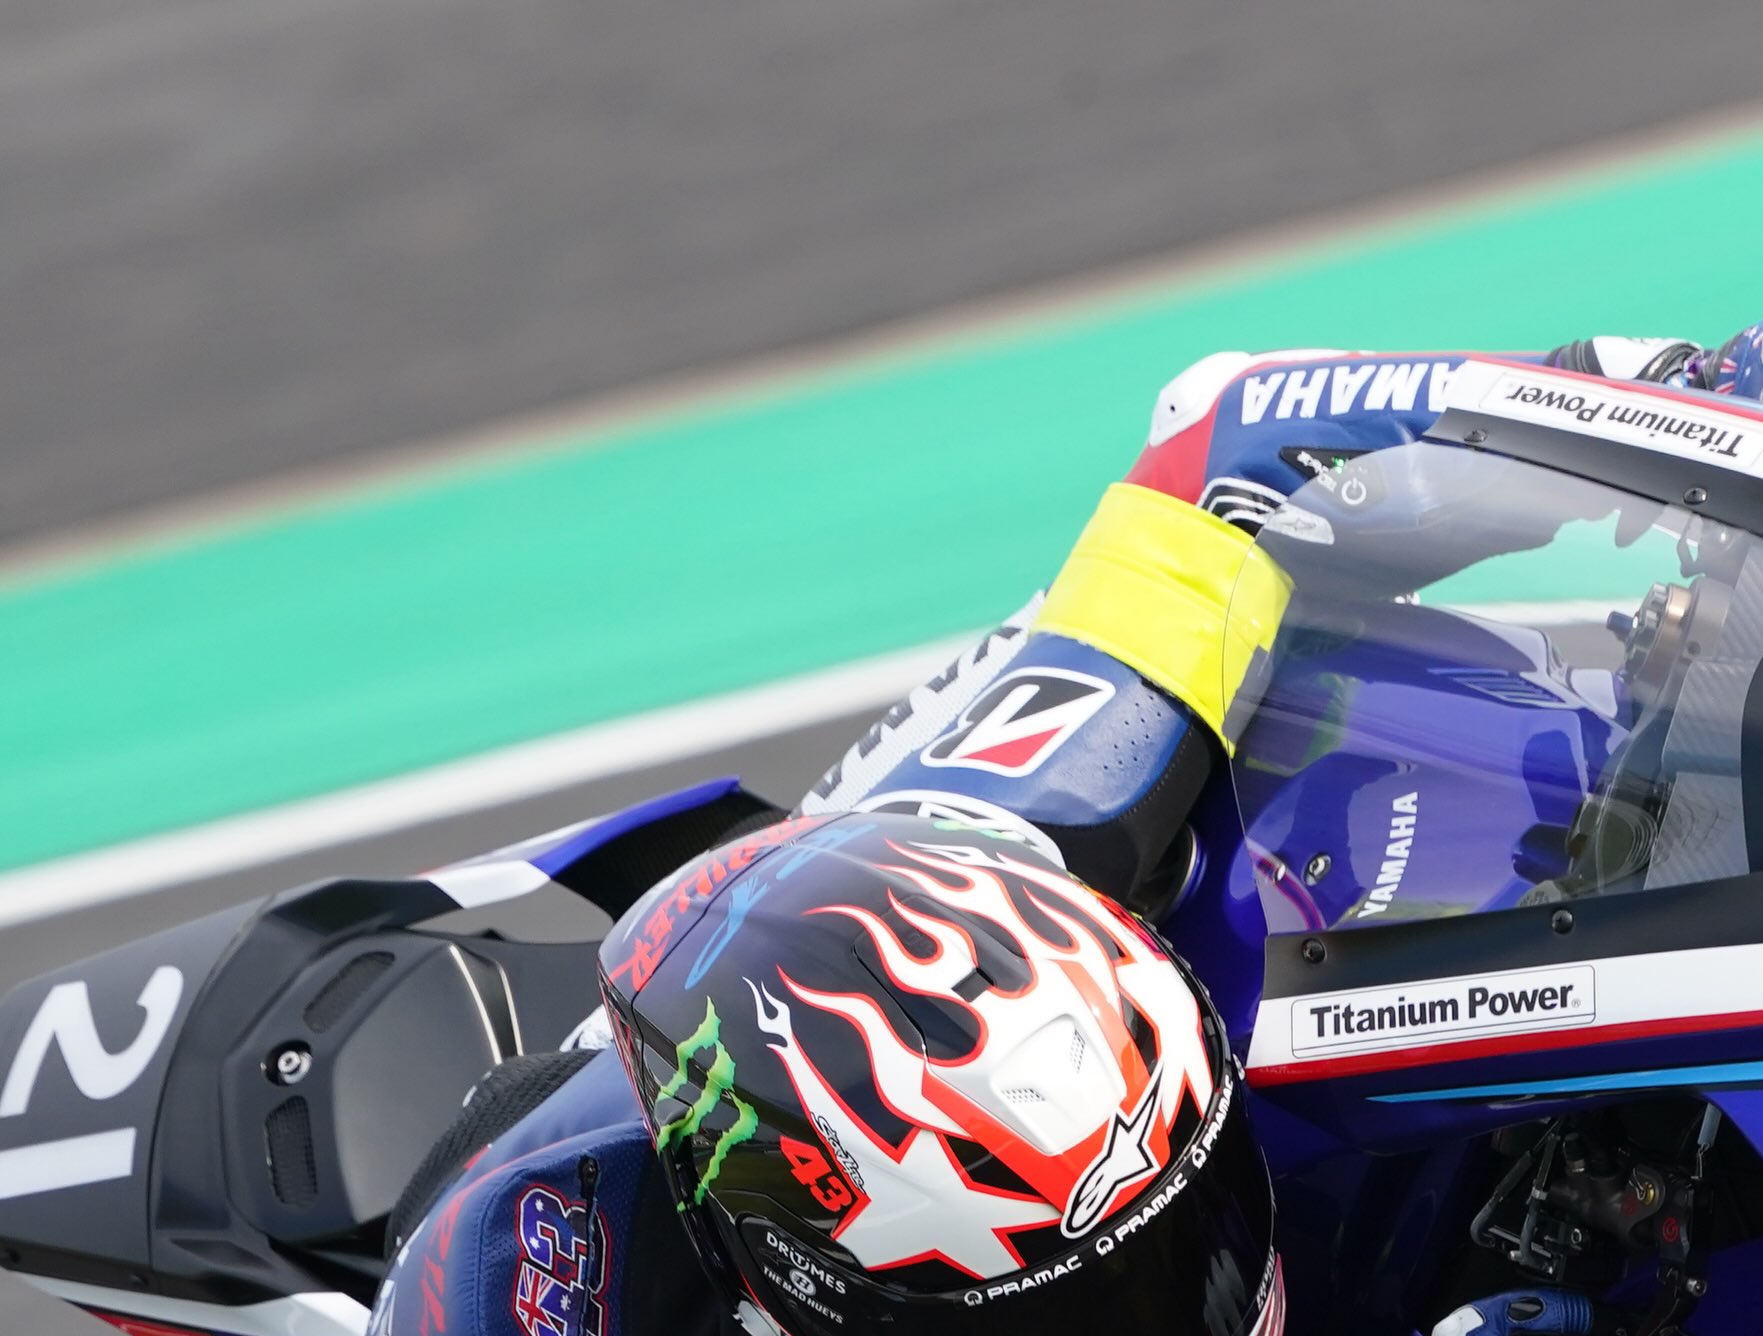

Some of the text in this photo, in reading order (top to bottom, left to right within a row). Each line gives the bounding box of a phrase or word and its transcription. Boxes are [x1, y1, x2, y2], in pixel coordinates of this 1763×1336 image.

[1241, 361, 1467, 424] AMAHA
[1505, 381, 1744, 458] Titanium Power
[1357, 791, 1418, 918] YAMAHA
[1310, 996, 1459, 1038] Titanium
[0, 966, 183, 1198] 21
[1201, 1074, 1234, 1151] PRAMAC
[780, 1135, 852, 1212] 43
[1114, 1172, 1188, 1242] PRAMAC
[763, 1265, 843, 1324] THE MAD HUEYS
[987, 1254, 1082, 1300] PRAMAC
